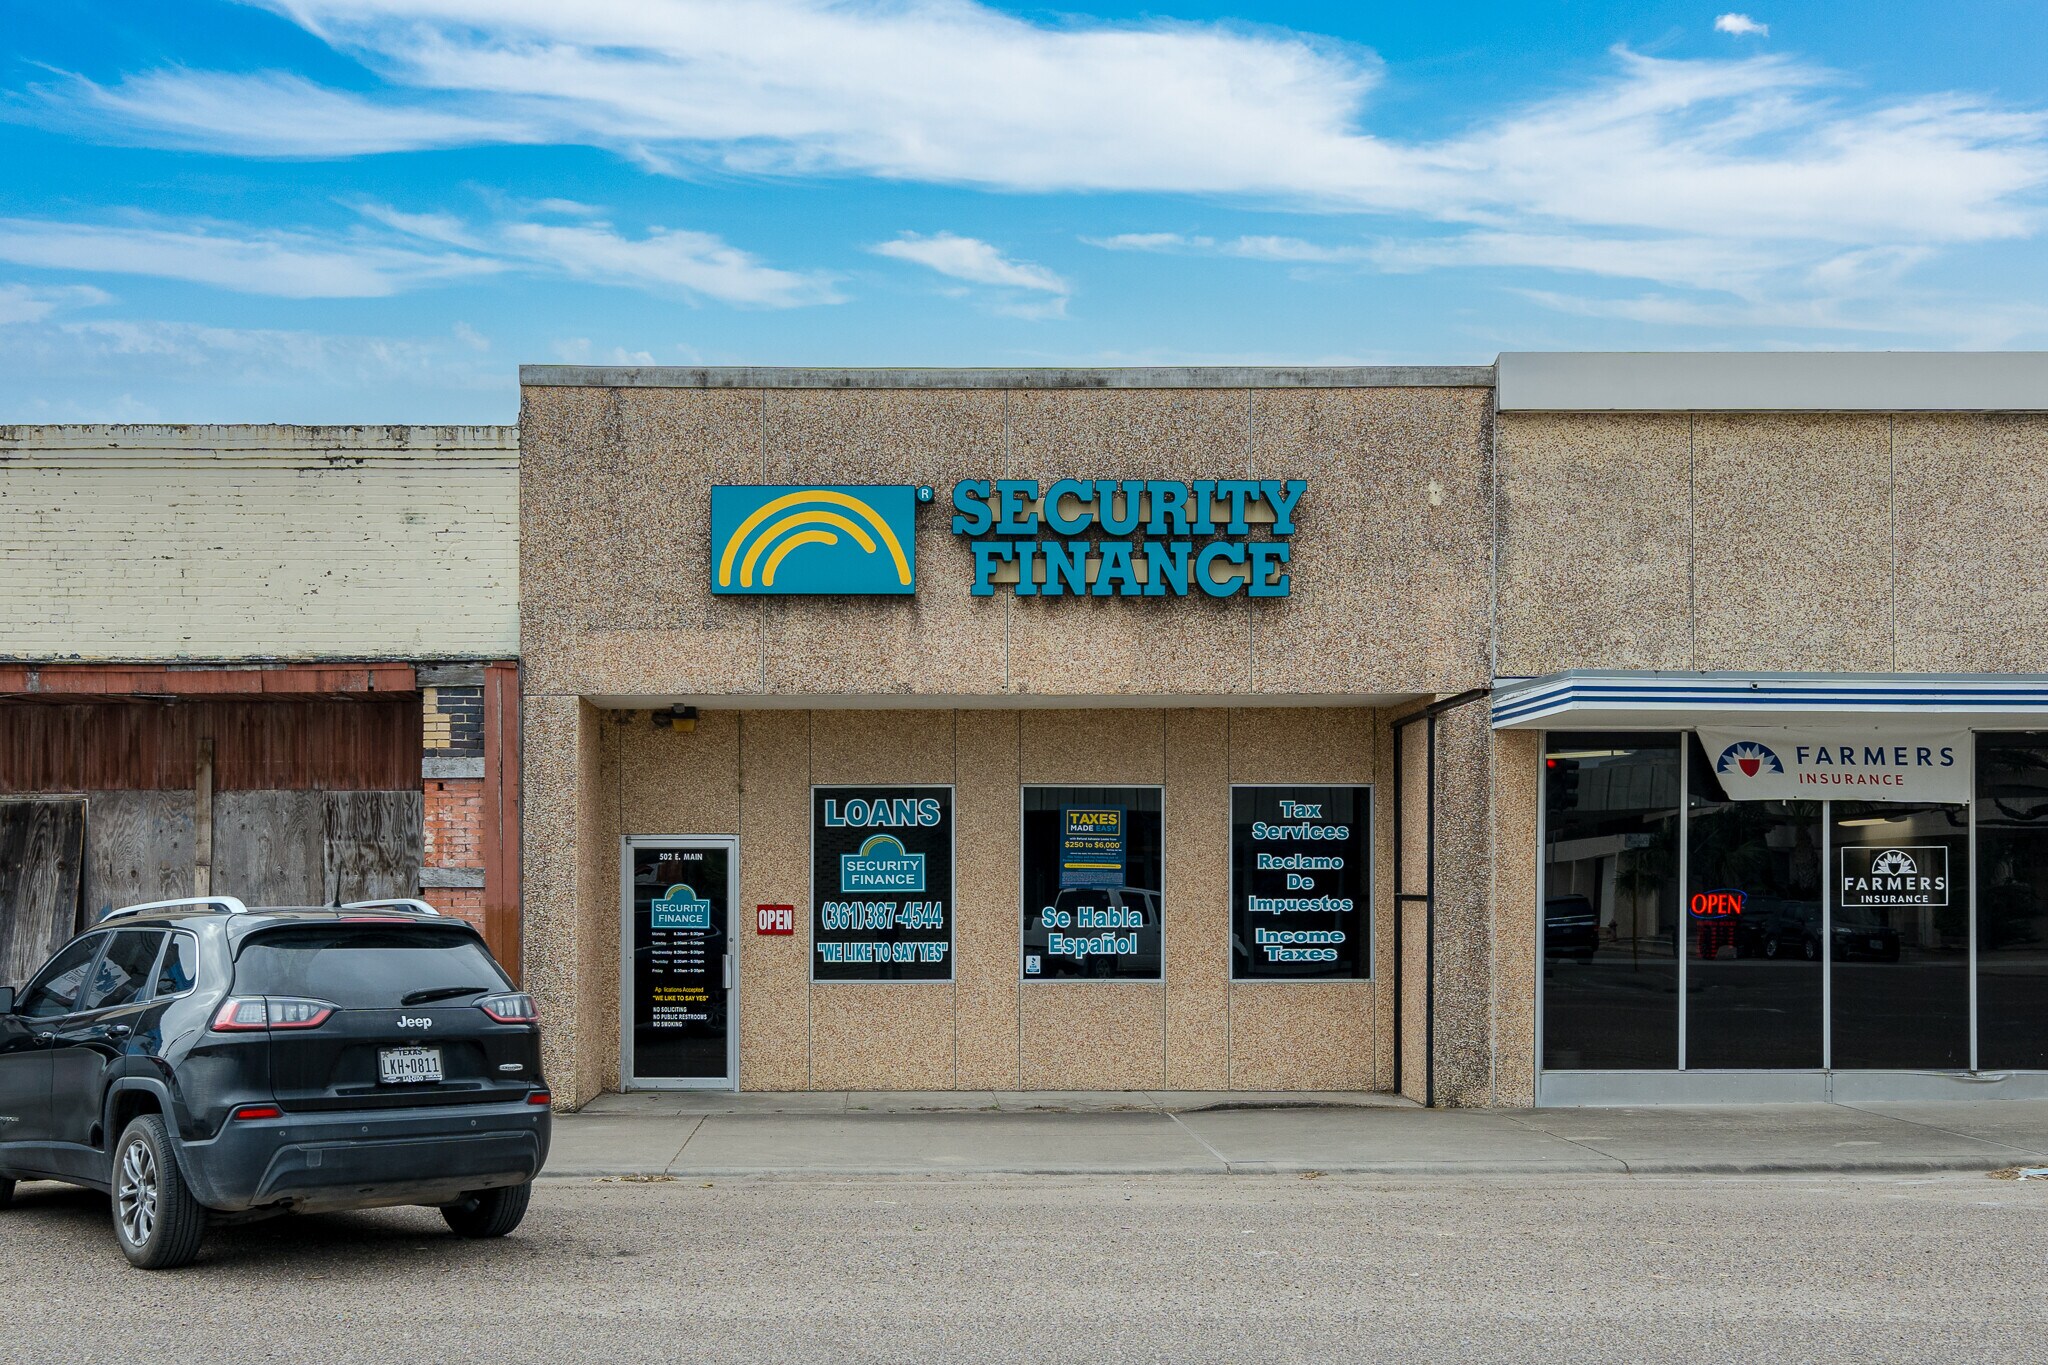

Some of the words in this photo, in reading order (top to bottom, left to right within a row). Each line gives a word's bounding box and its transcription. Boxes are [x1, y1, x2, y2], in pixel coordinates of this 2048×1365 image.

[952, 478, 1307, 536] SECURITY
[970, 541, 1290, 597] FINANCE
[1796, 745, 1955, 767] FARMERS
[1799, 773, 1904, 786] INSURANCE
[825, 799, 941, 827] LOANS
[1279, 800, 1322, 819] Tax
[1070, 813, 1118, 825] TAXES
[1252, 822, 1350, 840] Services
[659, 853, 673, 861] 502
[675, 853, 681, 861] E.
[683, 853, 703, 861] MAIN
[846, 860, 920, 871] SECURITY
[1257, 853, 1344, 870] Reclamo
[851, 874, 915, 885] FINANCE
[1287, 873, 1315, 890] De
[1844, 876, 1945, 891] FARMERS
[1248, 894, 1354, 915] Impuestos
[1691, 893, 1742, 914] OPEN
[1861, 895, 1929, 903] INSURANCE
[655, 904, 706, 912] SECURITY
[822, 901, 943, 930] (361)387-4544
[658, 914, 703, 923] FINANCE
[758, 909, 792, 931] OPEN
[1041, 906, 1071, 928] Se
[1077, 906, 1144, 928] Habla
[1255, 927, 1346, 944] Income
[843, 942, 873, 963] LIKE
[873, 942, 892, 963] TO
[892, 942, 918, 963] SAY
[1048, 931, 1138, 960] Español
[1263, 945, 1338, 962] Taxes
[397, 1015, 433, 1029] Jeep
